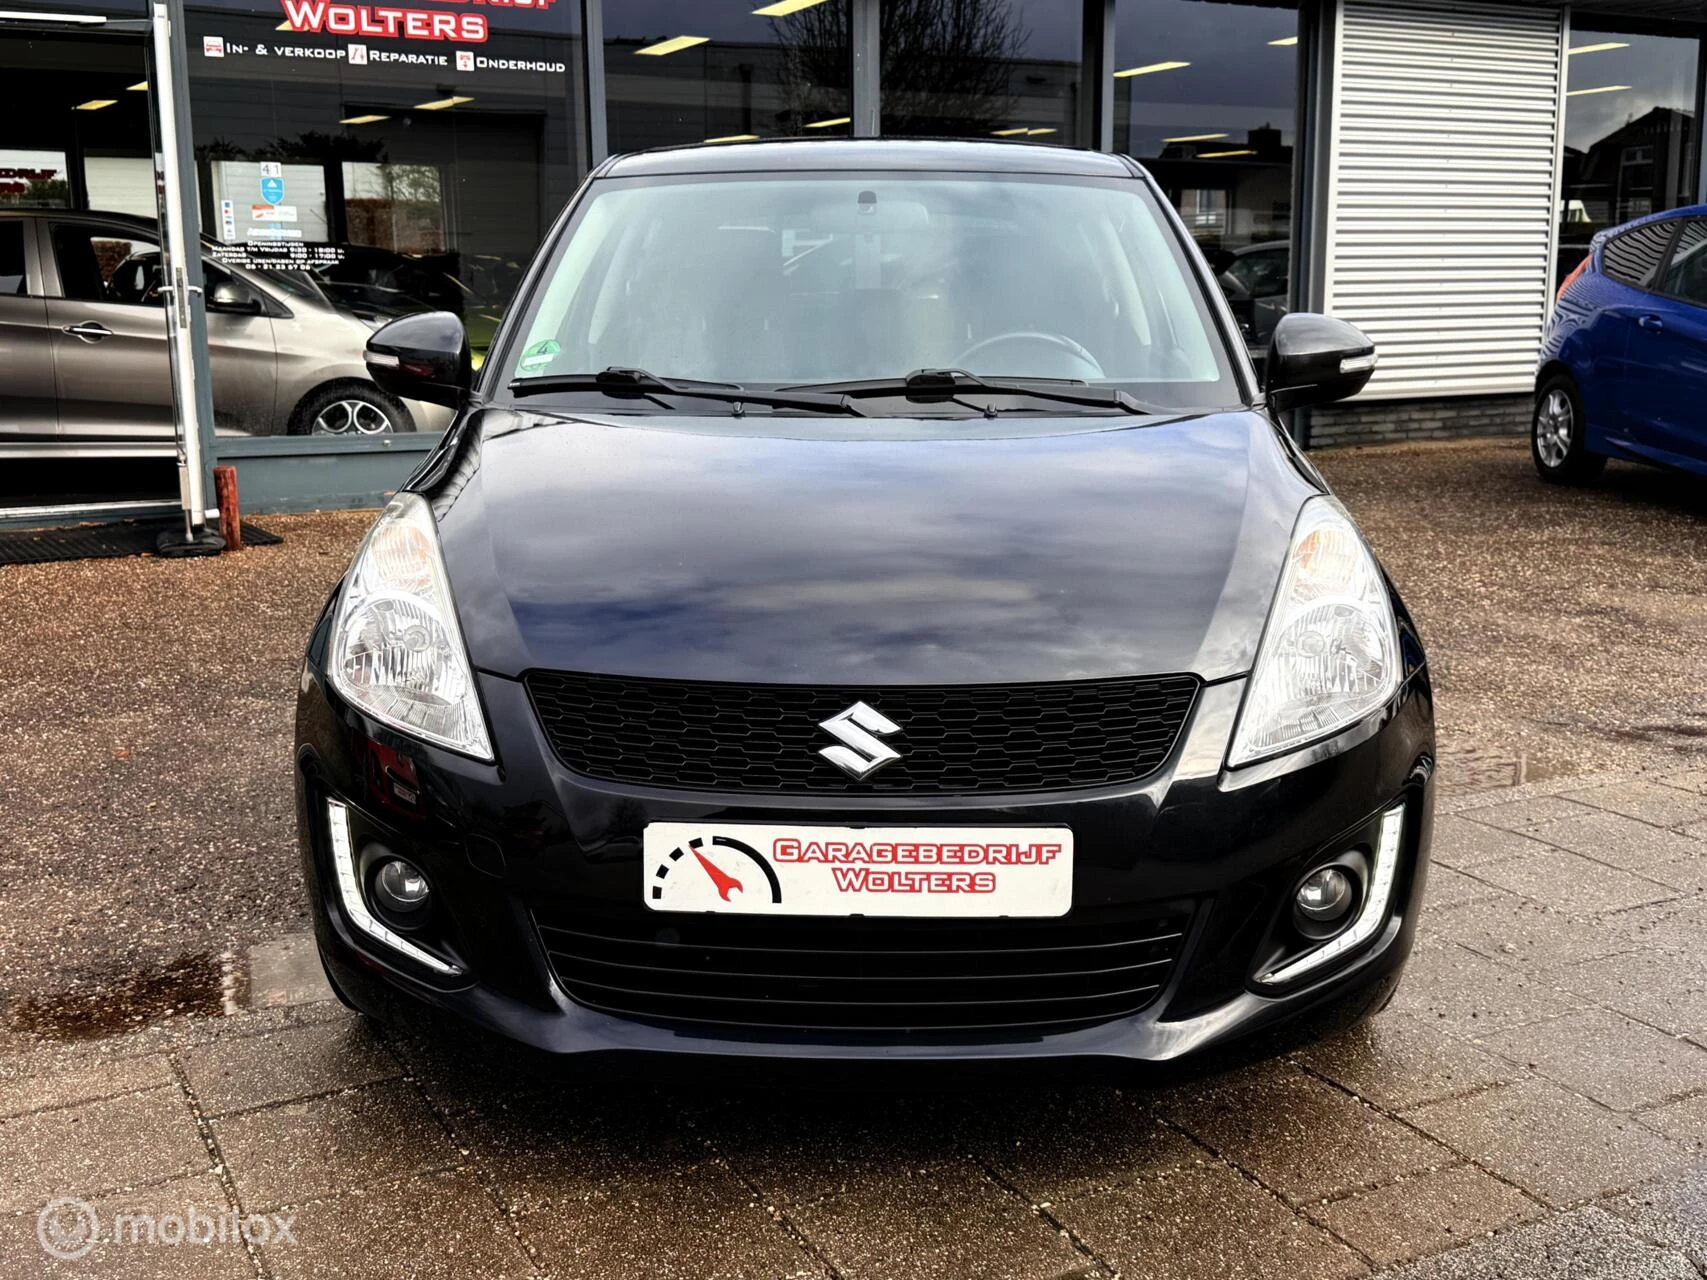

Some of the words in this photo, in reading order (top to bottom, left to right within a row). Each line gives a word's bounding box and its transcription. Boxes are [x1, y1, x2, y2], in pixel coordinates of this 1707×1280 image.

[283, 0, 488, 42] WOLTERS
[225, 42, 249, 54] IN-
[255, 44, 268, 55] &
[274, 46, 346, 60] VERKOOP
[369, 50, 448, 66] REPARATIE
[475, 56, 566, 73] ONDERHOUD
[773, 837, 1062, 865] GARAGEBEDRIJF
[831, 866, 997, 894] WOLTERS
